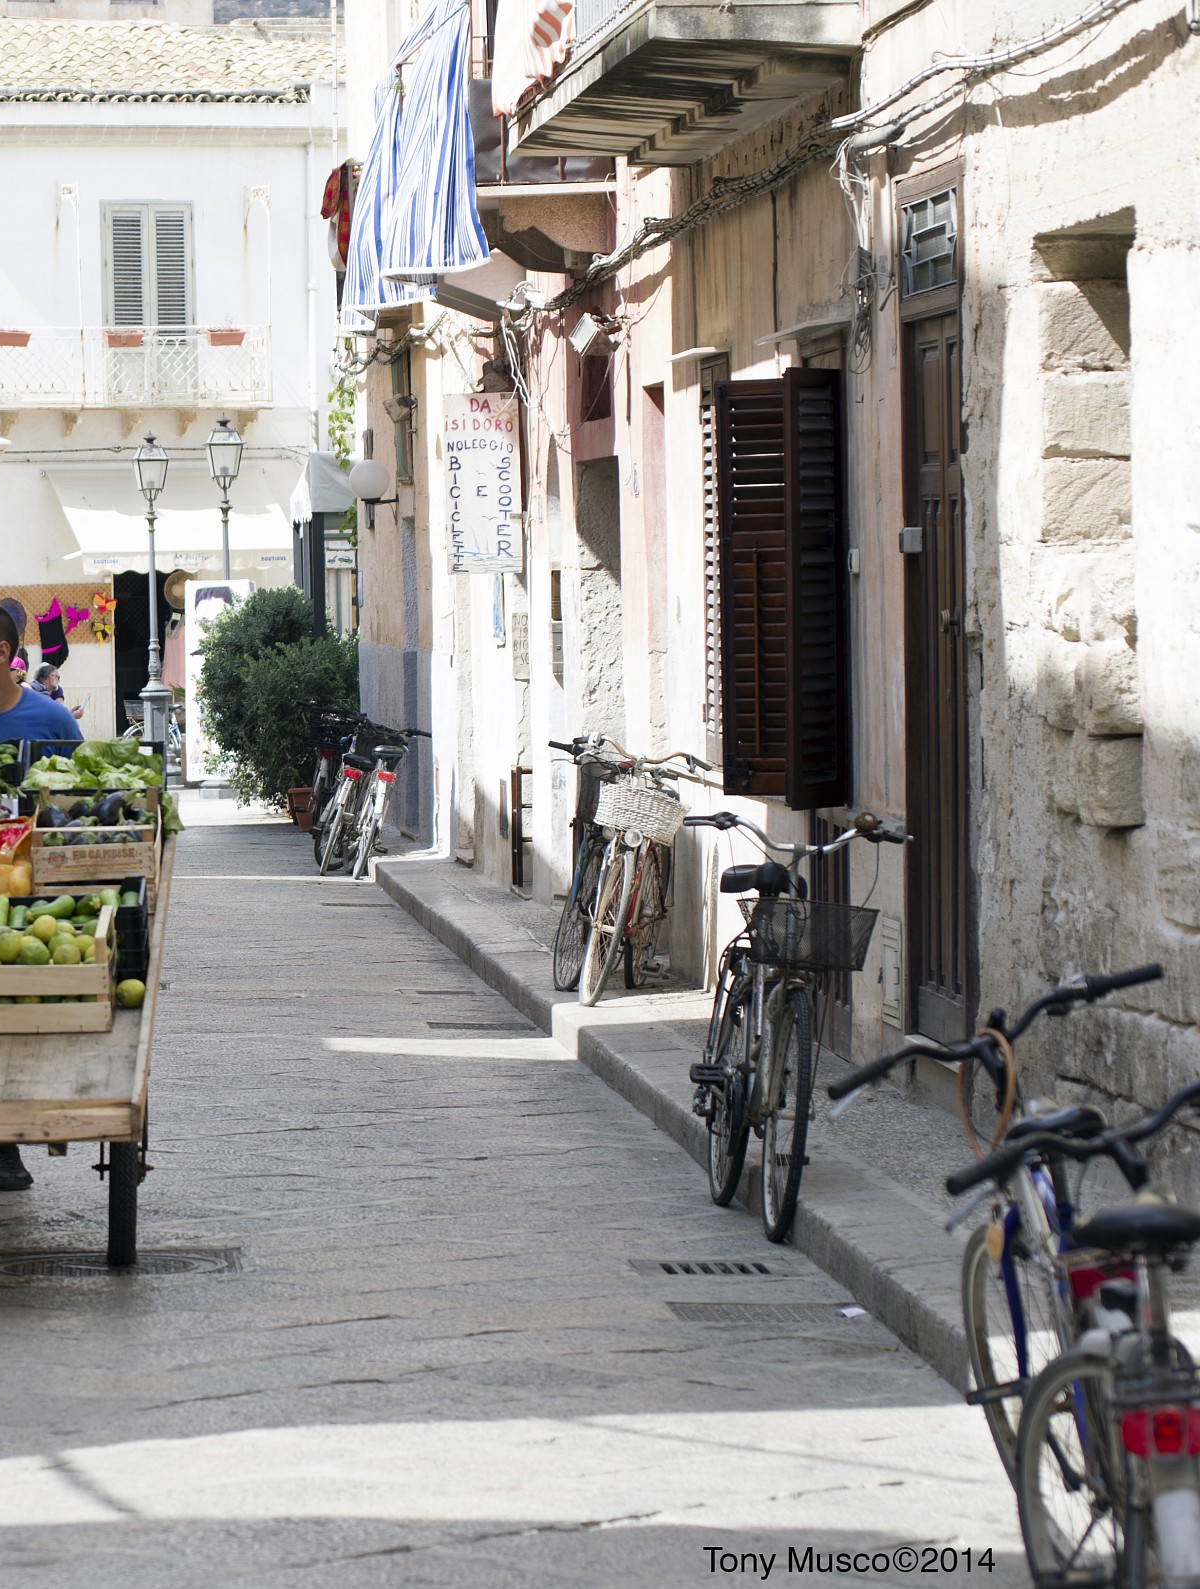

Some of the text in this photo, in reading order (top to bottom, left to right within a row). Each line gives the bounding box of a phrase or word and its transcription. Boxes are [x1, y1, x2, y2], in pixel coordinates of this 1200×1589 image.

[470, 398, 491, 413] DA
[448, 456, 469, 573] BICICLETTE
[476, 485, 488, 497] E
[496, 456, 514, 558] SCOOTER
